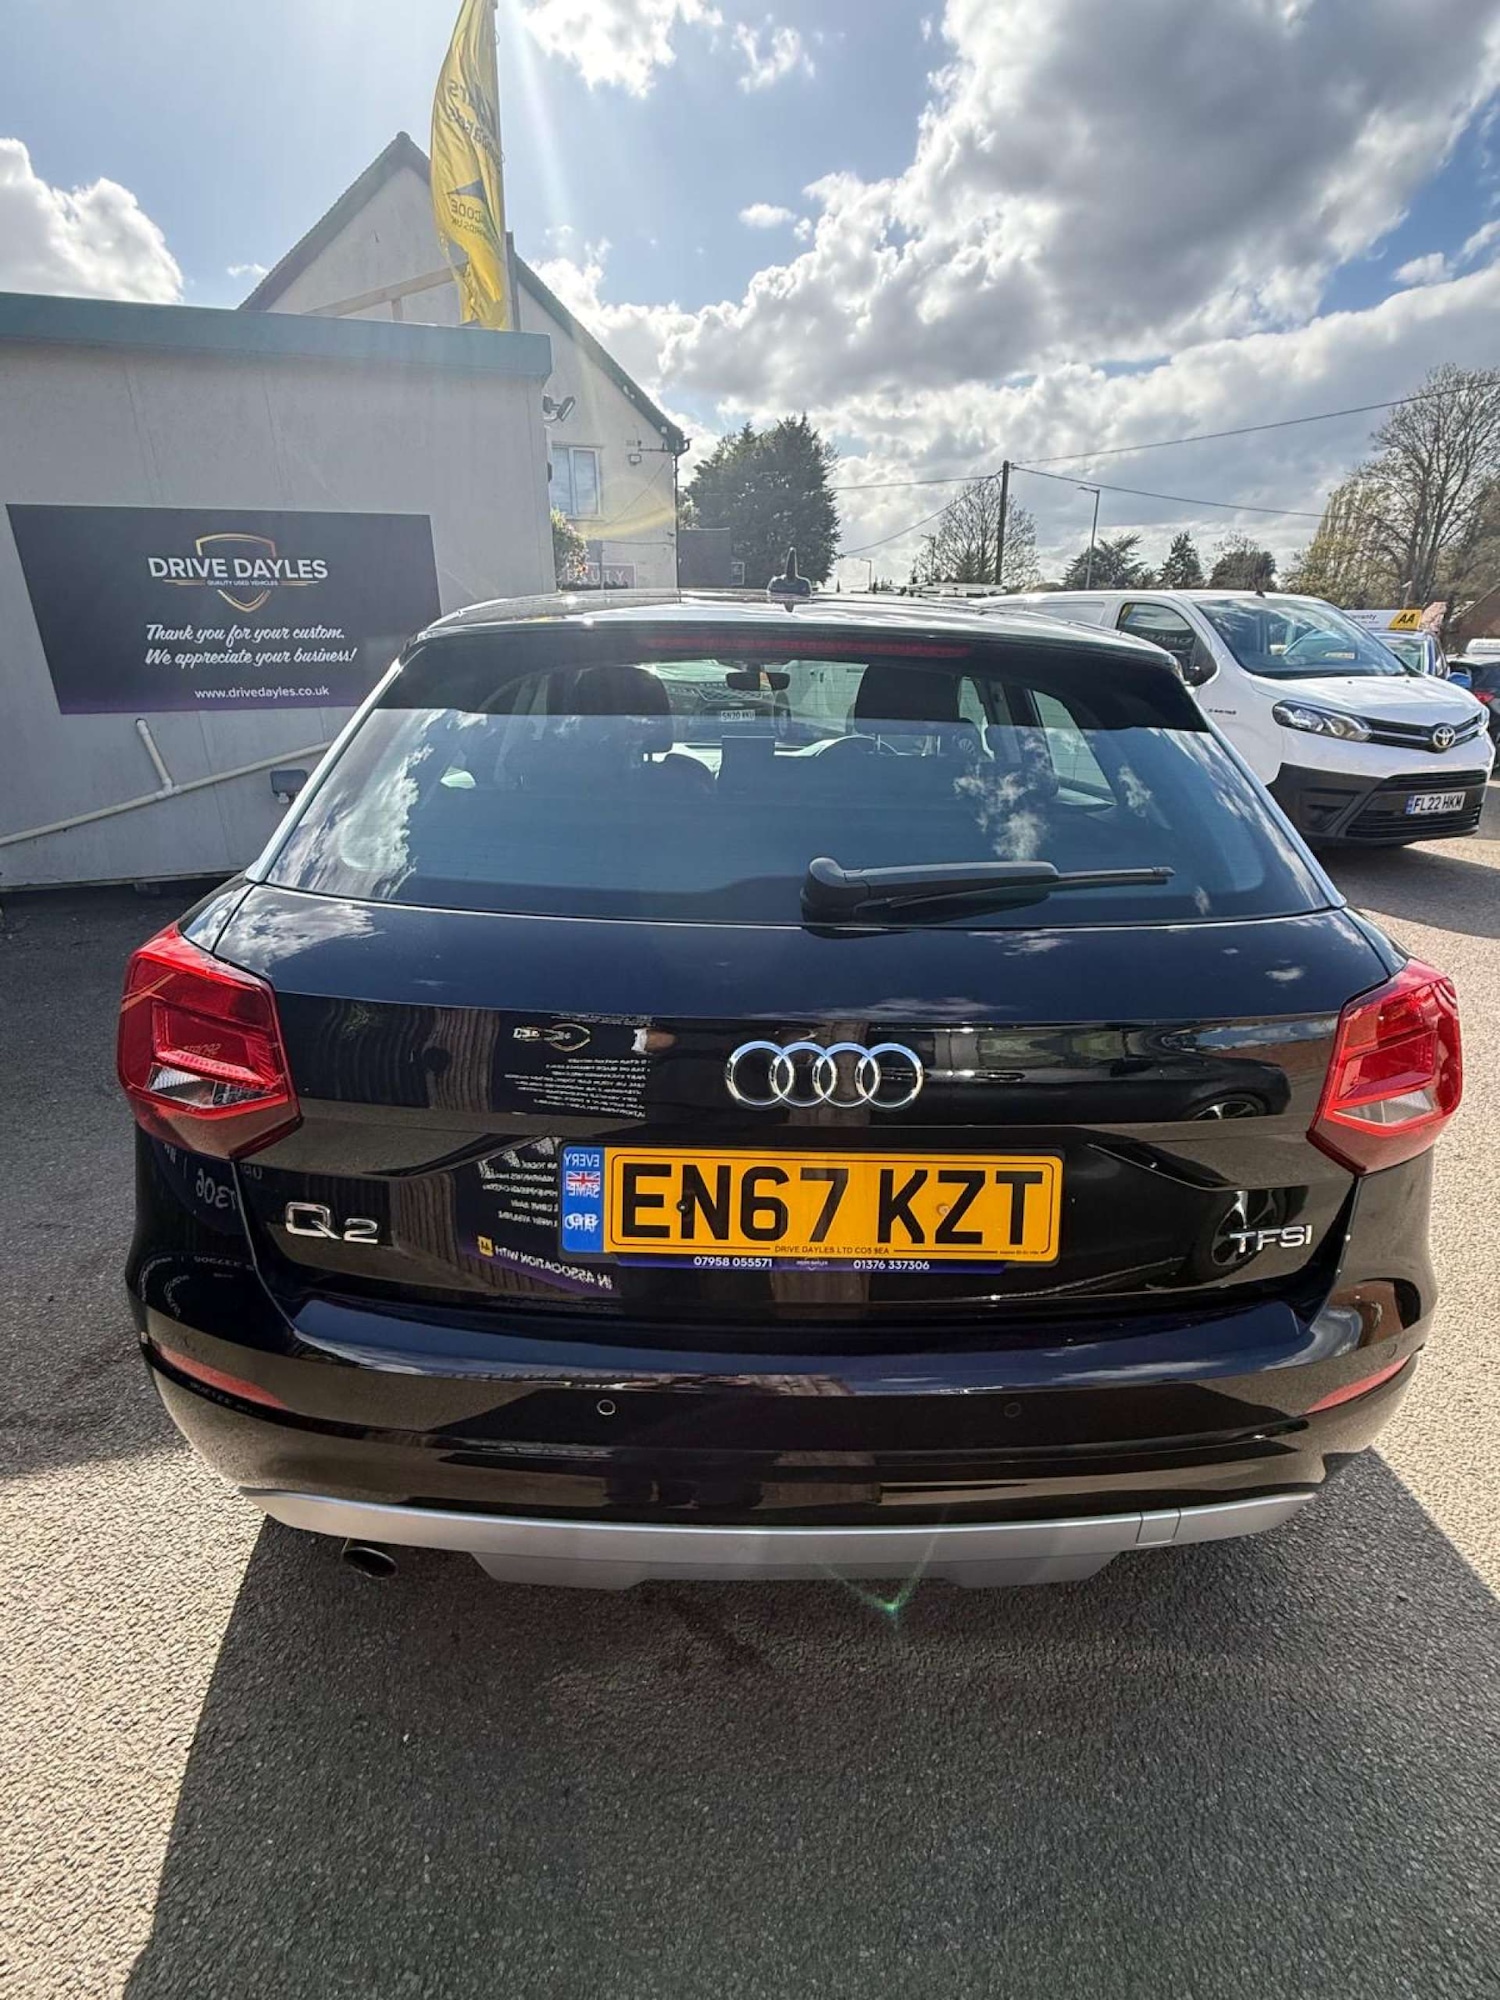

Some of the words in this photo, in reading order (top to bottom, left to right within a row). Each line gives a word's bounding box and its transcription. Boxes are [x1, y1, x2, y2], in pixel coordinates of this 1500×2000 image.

[148, 557, 228, 578] DRIVE
[234, 558, 328, 579] DAYLES
[1397, 613, 1416, 624] AA
[146, 624, 193, 640] Thank
[194, 628, 226, 644] you
[226, 625, 251, 648] for
[252, 628, 290, 643] your
[292, 625, 345, 640] custom.
[145, 649, 172, 664] We
[174, 649, 252, 669] appreciate
[253, 651, 291, 667] your
[293, 648, 358, 664] business!
[194, 686, 330, 699] www.drivedayles.co.uk
[1414, 797, 1441, 811] FL22
[622, 1163, 849, 1243] EN67
[877, 1169, 1043, 1245] KZT
[286, 1201, 378, 1244] Q2
[1229, 1225, 1313, 1253] TFSI
[775, 1245, 800, 1253] DRIVE
[693, 1256, 730, 1267] 07958
[732, 1257, 773, 1267] 055571
[853, 1260, 885, 1269] 01376
[888, 1260, 930, 1270] 337306
